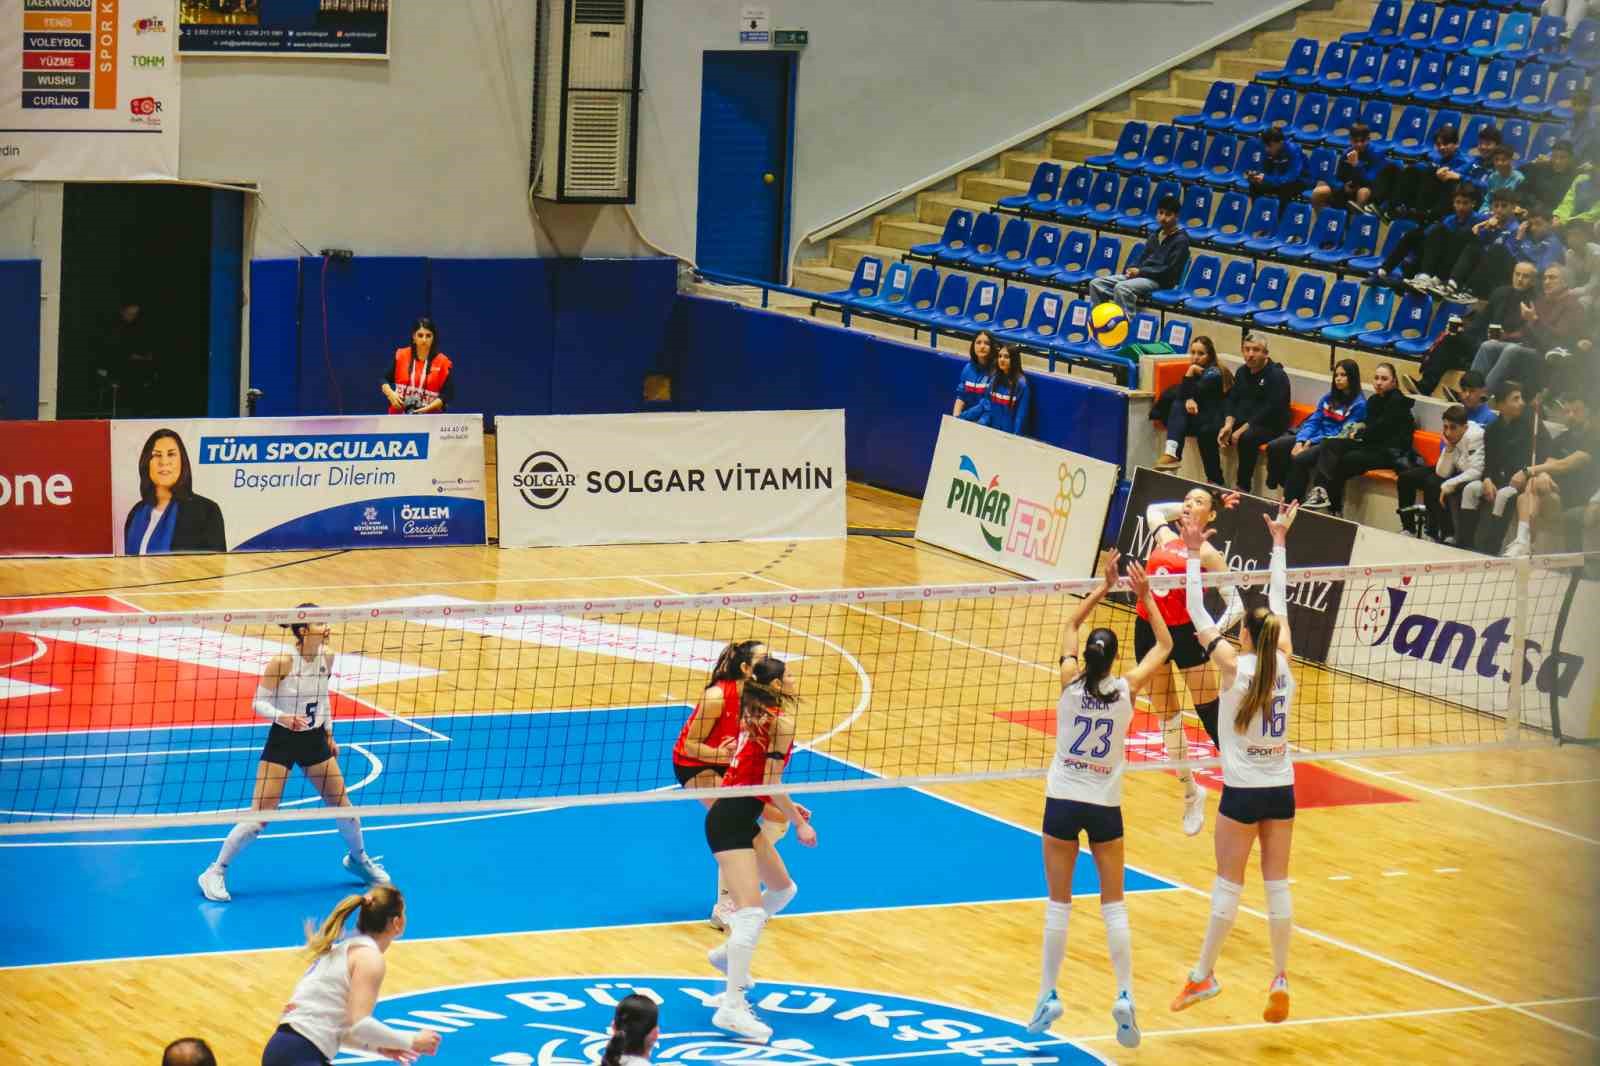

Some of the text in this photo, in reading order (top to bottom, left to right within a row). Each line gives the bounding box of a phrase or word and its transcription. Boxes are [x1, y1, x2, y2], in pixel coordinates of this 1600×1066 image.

[30, 38, 85, 48] VOLEYBOL
[40, 56, 75, 67] YÜZME
[38, 76, 76, 86] WUSHU
[33, 95, 79, 106] CURLİNG
[207, 437, 420, 462] TÜM SPORCULARA
[233, 464, 396, 492] Başarılar Dilerim
[512, 473, 577, 488] SOLGAR
[586, 461, 833, 494] SOLGAR VİTAMİN
[400, 504, 450, 520] ÖZLEM
[305, 702, 319, 728] 5
[1068, 715, 1114, 759] 23
